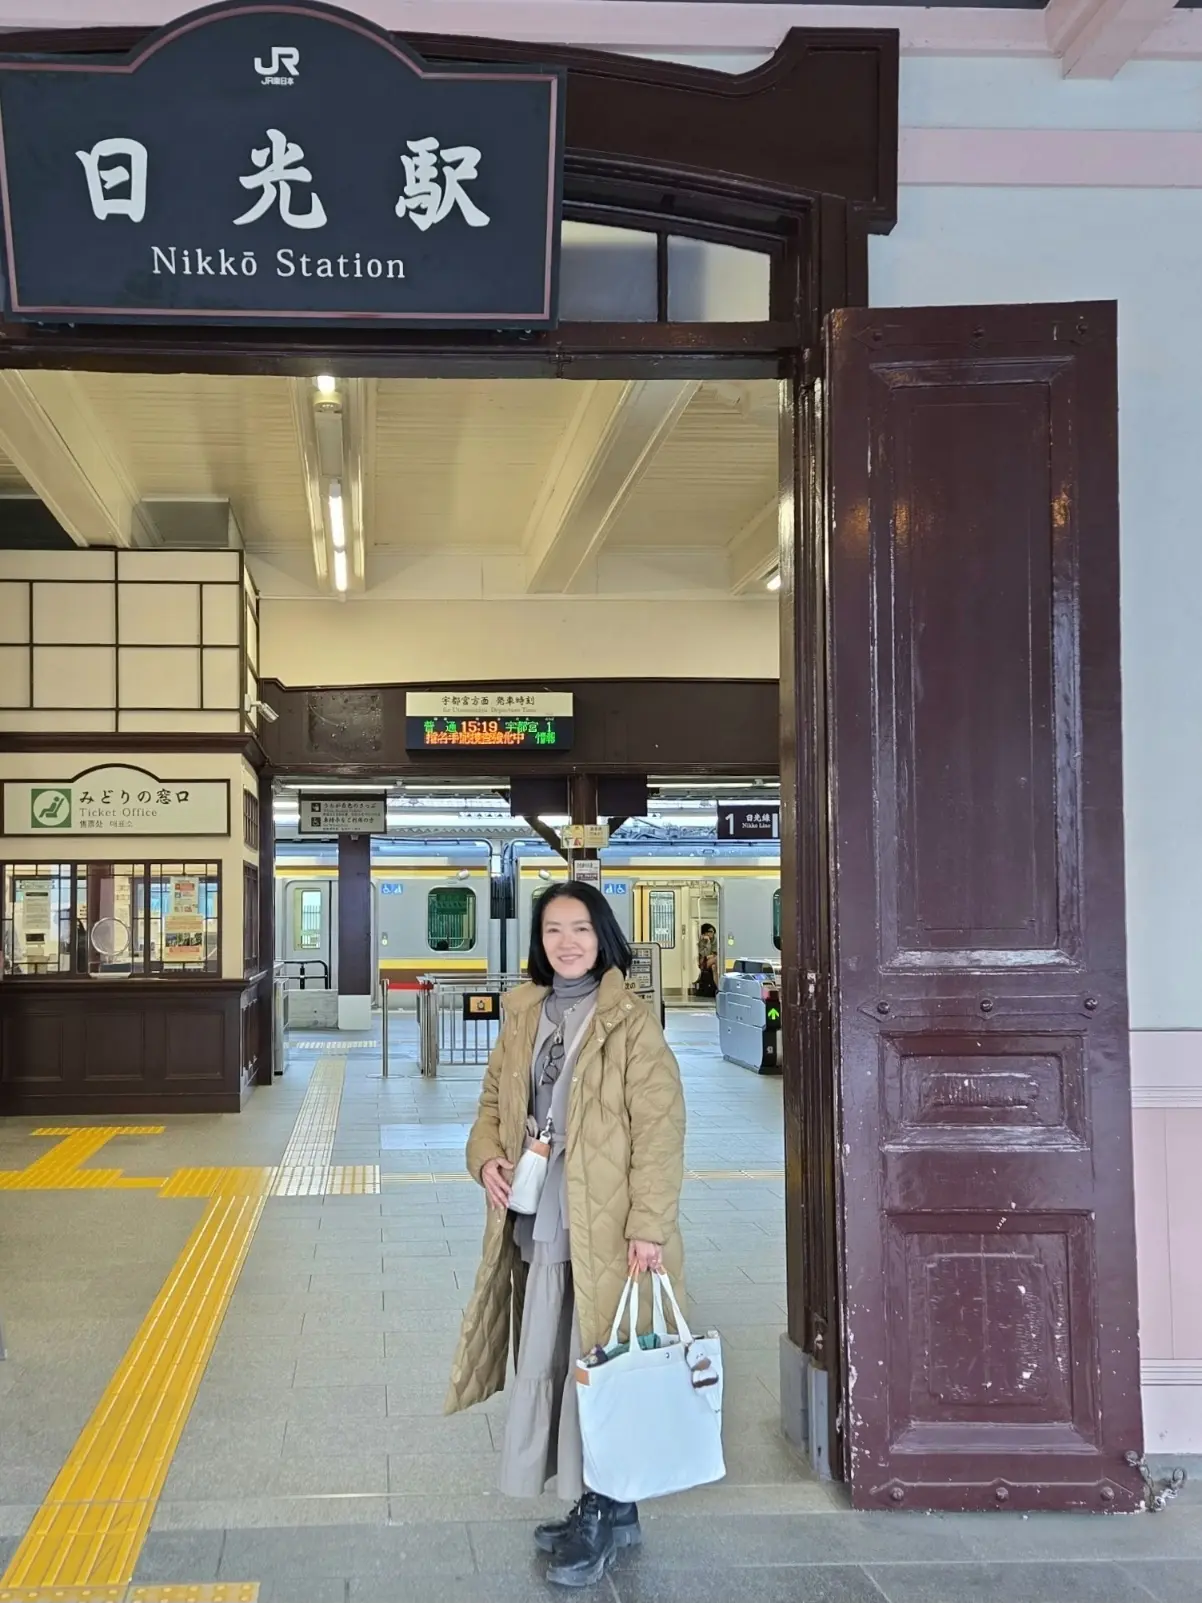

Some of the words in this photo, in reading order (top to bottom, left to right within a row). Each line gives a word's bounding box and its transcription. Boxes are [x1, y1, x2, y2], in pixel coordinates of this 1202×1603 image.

[254, 46, 300, 75] JR
[261, 76, 295, 86] JR東日本
[75, 128, 491, 231] 日光駅
[151, 246, 258, 278] Nikkō
[276, 248, 405, 279] Station
[441, 696, 489, 706] 宇都宮方面
[496, 696, 535, 706] 発車時刻
[461, 721, 498, 733] 15:19
[505, 721, 539, 733] 宇都宮
[546, 721, 552, 733] 1
[79, 788, 190, 805] みどりの窓口
[79, 807, 117, 817] Ticket
[122, 807, 158, 818] Office
[746, 813, 771, 822] 日光線
[725, 813, 735, 835] 1
